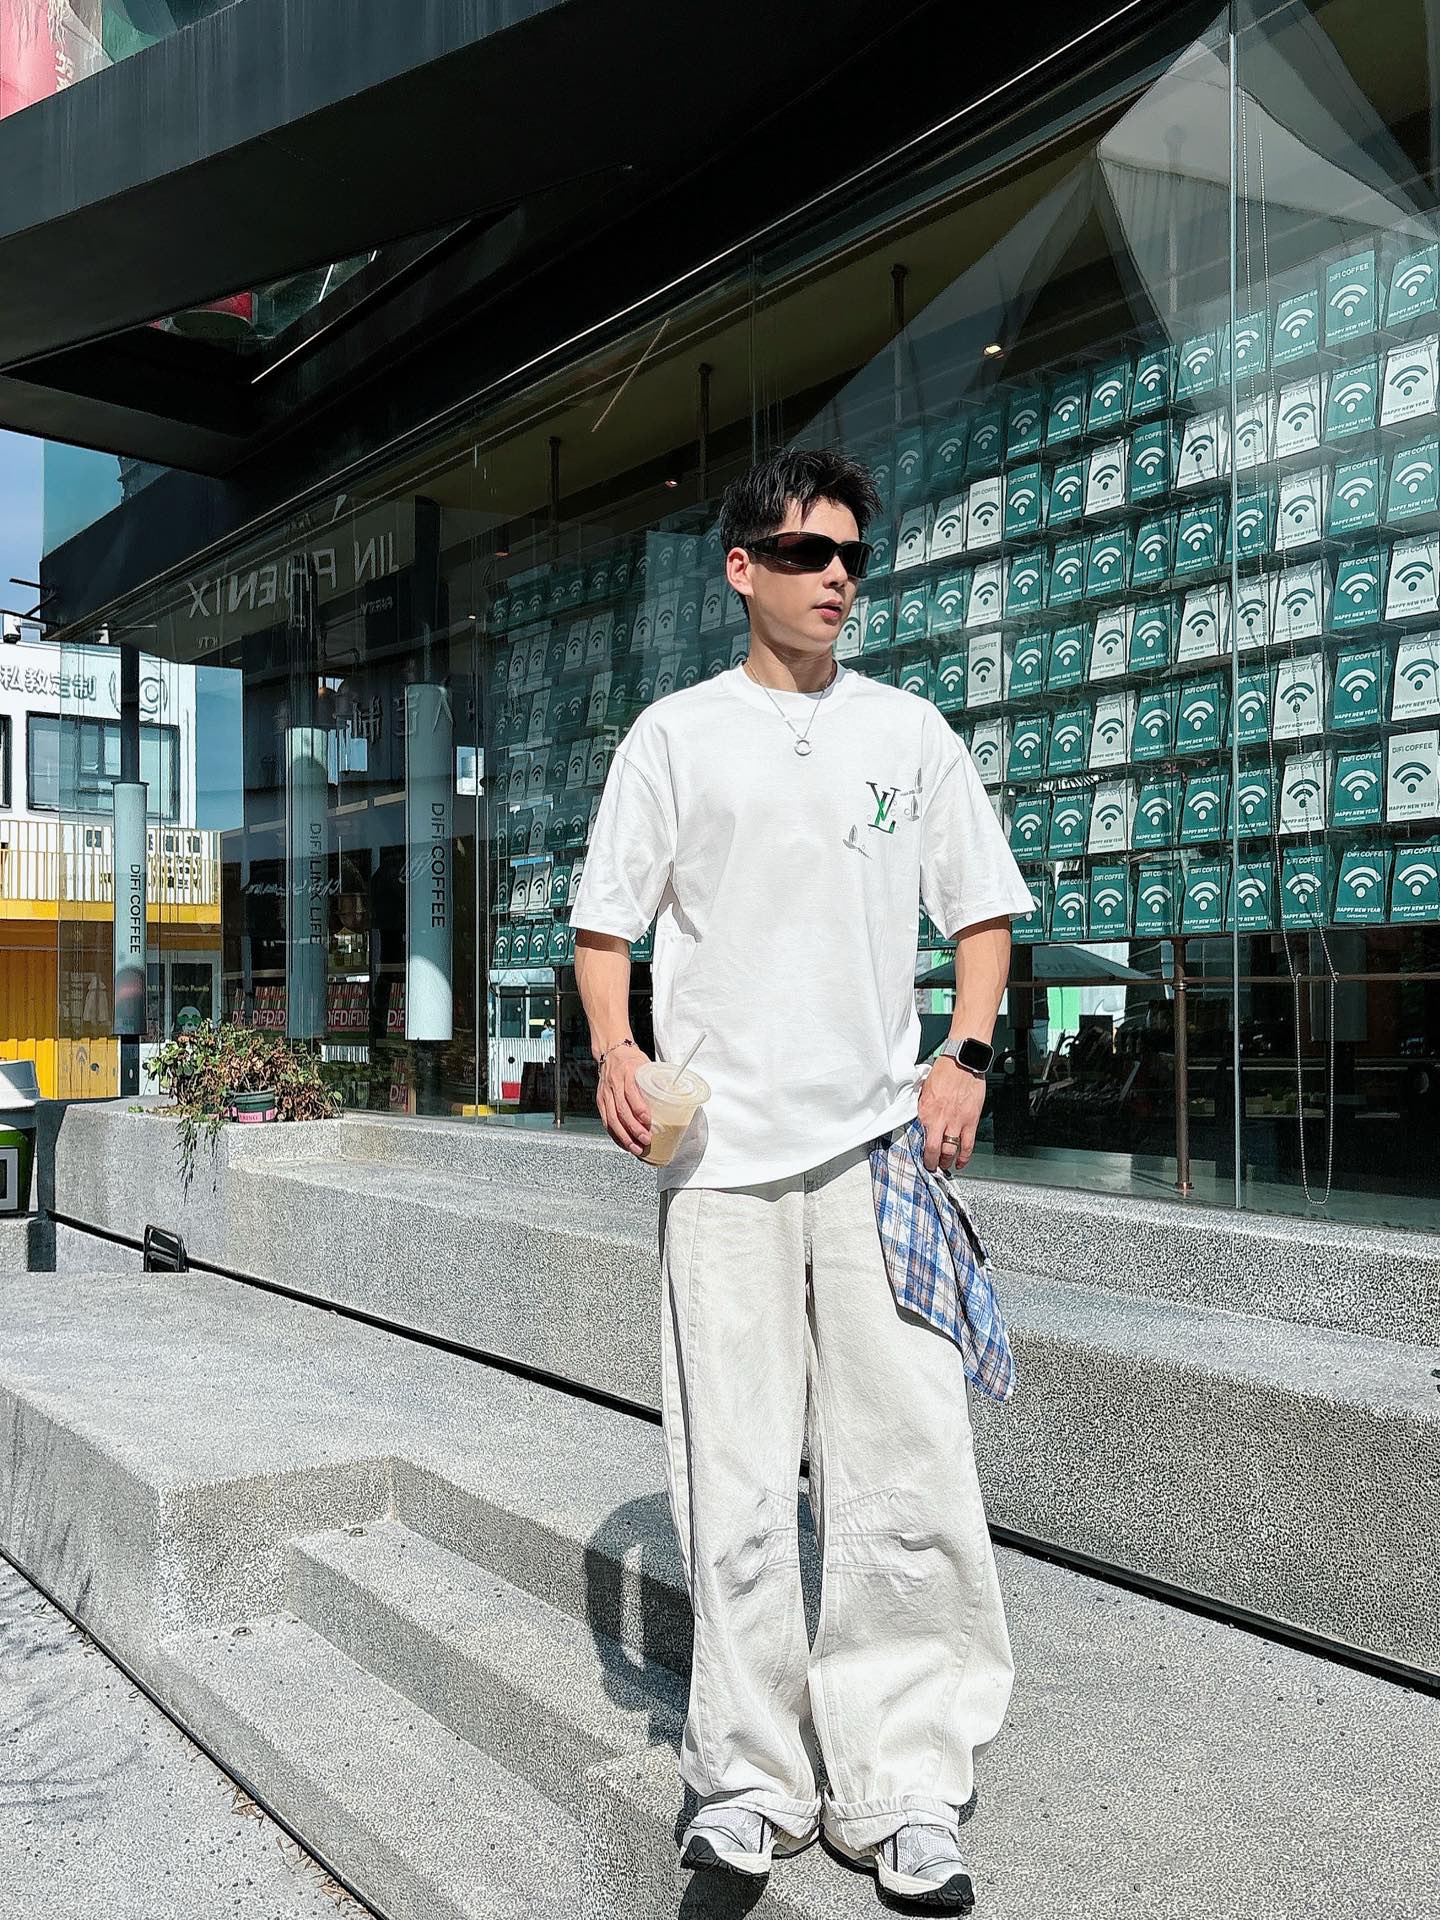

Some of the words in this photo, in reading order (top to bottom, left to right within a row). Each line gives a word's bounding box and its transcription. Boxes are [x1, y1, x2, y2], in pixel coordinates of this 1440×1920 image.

[1342, 264, 1369, 277] COFFEE
[1389, 504, 1406, 512] HAPPY
[1, 664, 97, 701] 私教定制
[1405, 743, 1432, 752] COFFEE
[431, 803, 444, 841] DiFi
[130, 864, 140, 892] DiFi
[431, 845, 445, 928] COFFEE
[130, 895, 141, 954] COFFEE
[310, 907, 321, 945] LIFE
